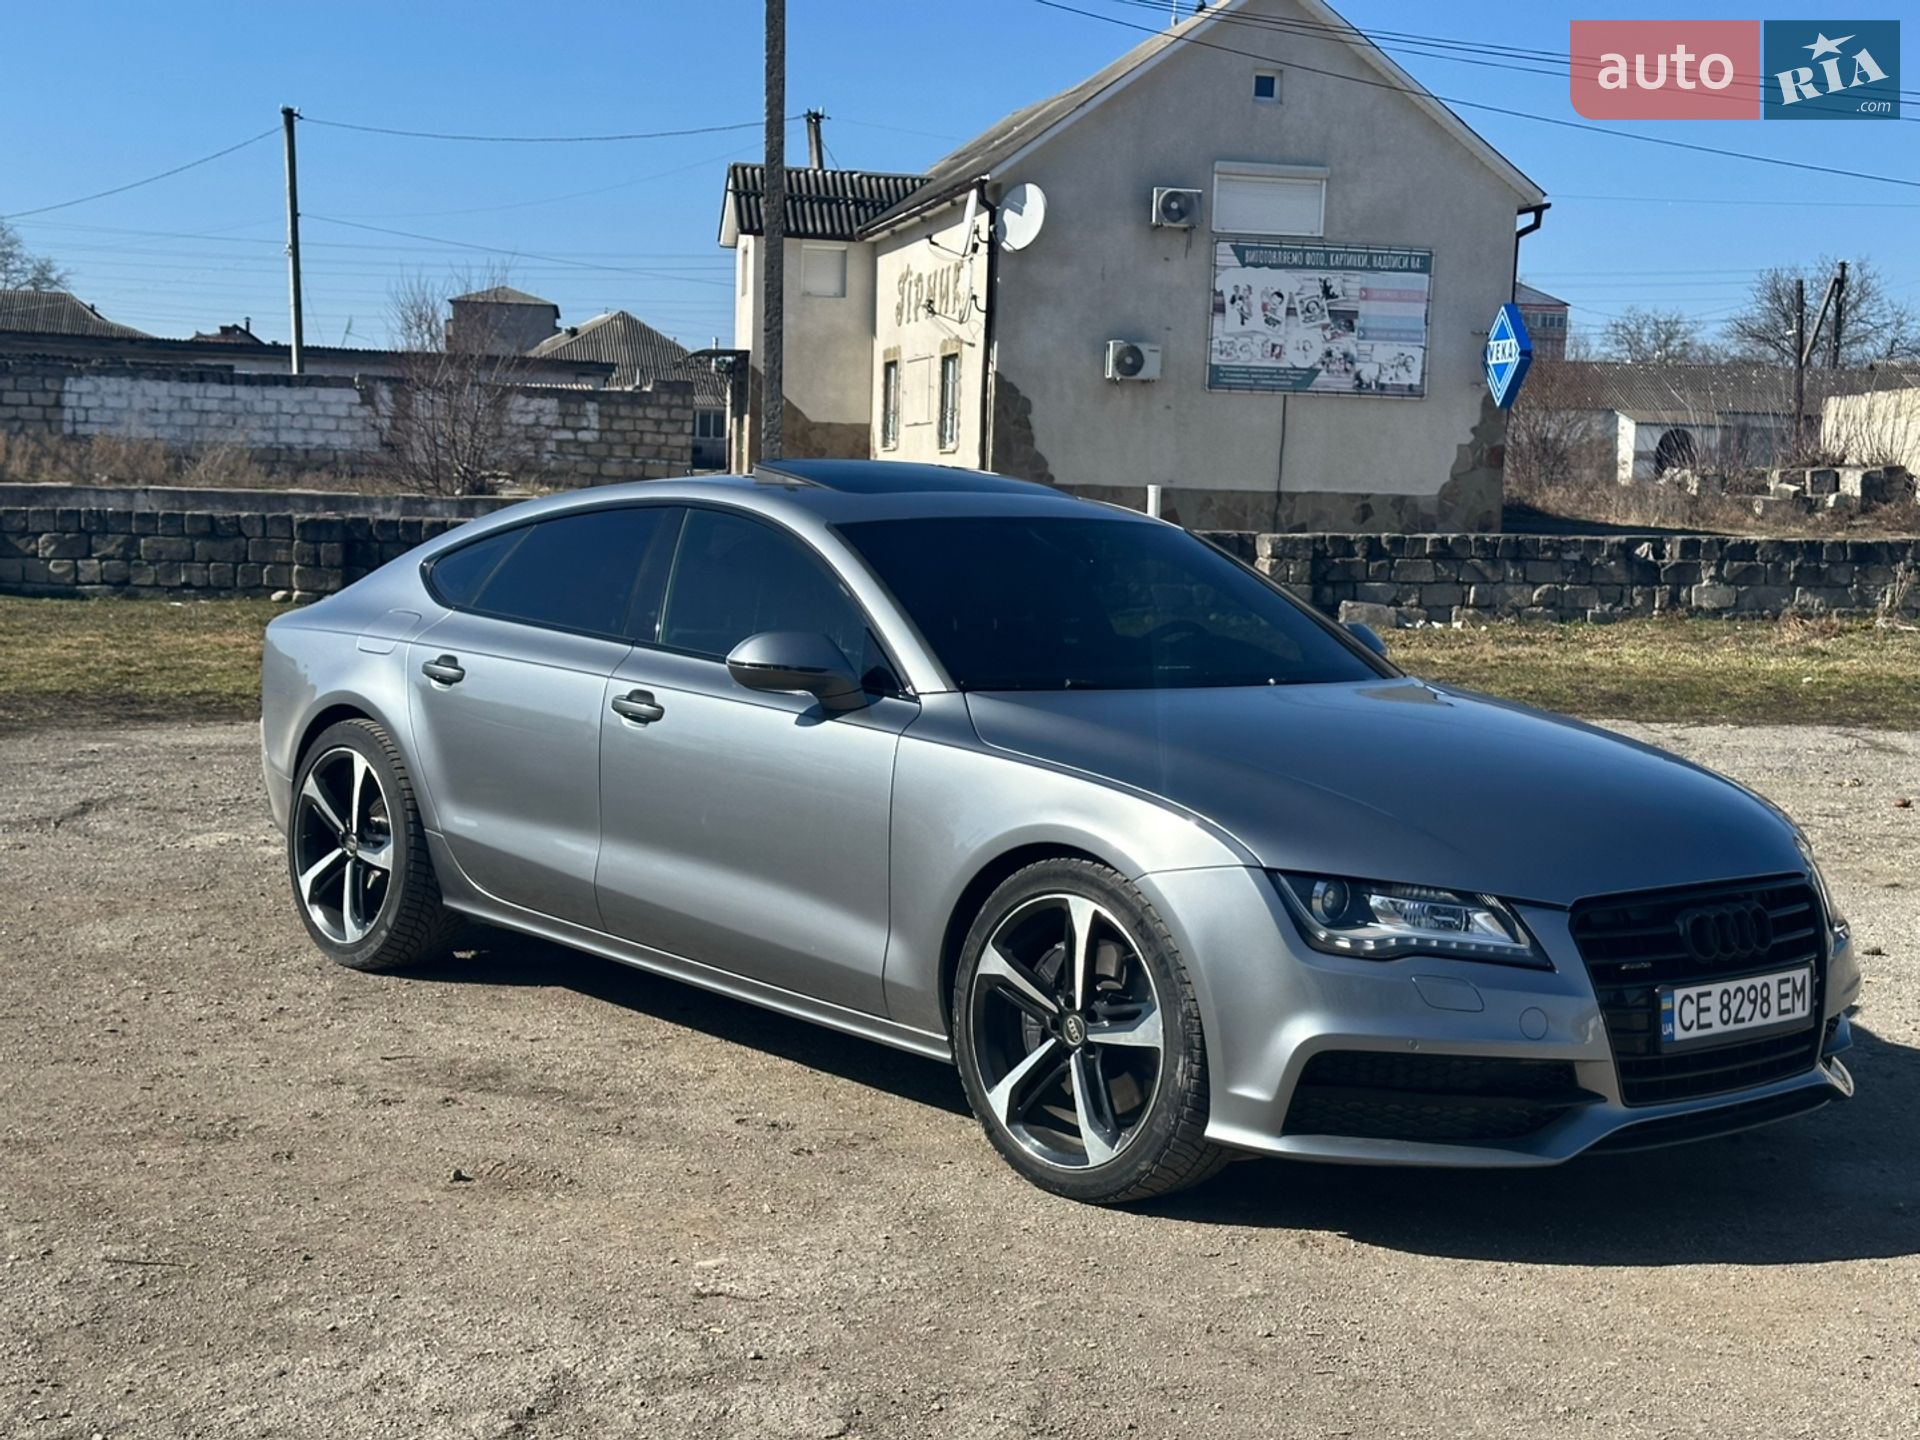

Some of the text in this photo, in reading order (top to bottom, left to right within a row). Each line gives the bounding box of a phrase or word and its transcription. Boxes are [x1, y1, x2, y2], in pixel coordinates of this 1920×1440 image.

[1488, 340, 1513, 362] VEKA
[1678, 975, 1806, 1032] CE 8298 EM
[1661, 1023, 1673, 1036] UA
